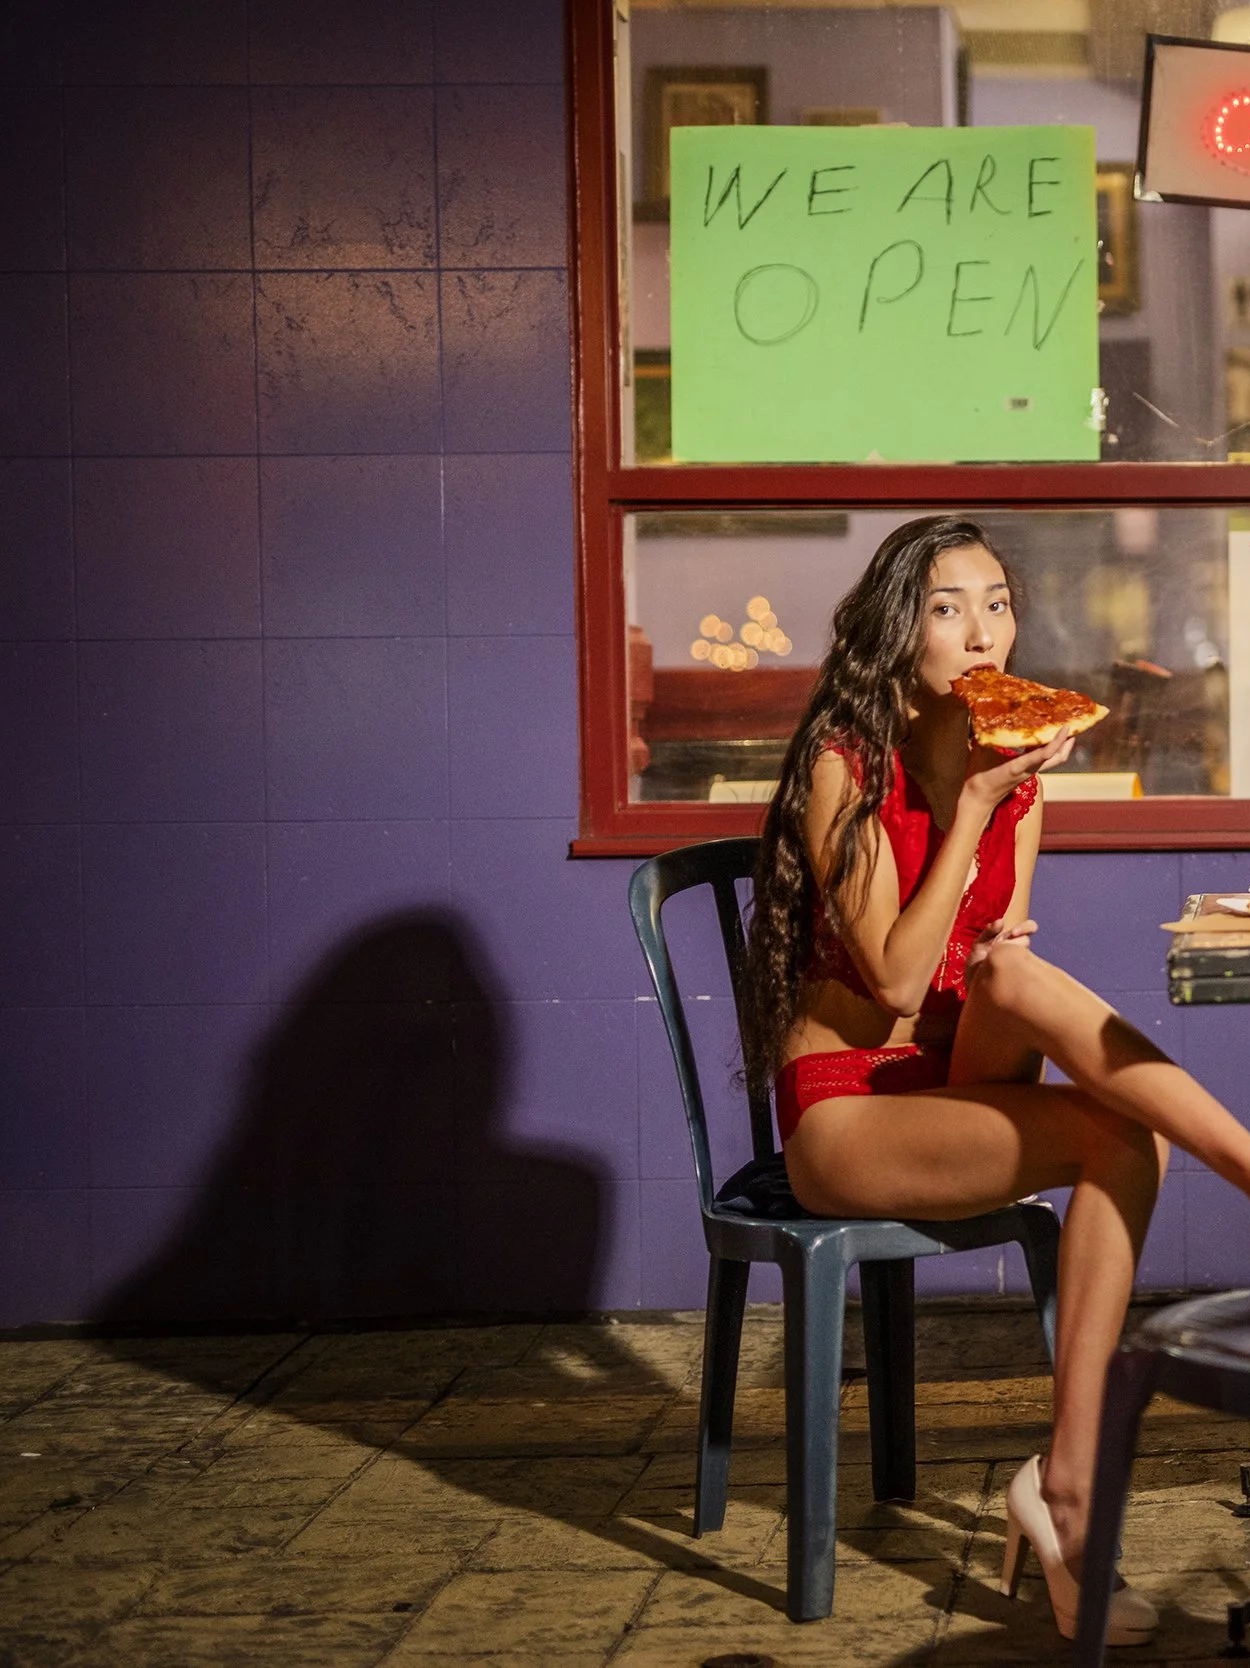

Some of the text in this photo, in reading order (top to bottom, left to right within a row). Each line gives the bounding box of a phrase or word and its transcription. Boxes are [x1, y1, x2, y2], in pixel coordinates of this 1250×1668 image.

[703, 154, 1063, 231] WE ARE
[733, 239, 1085, 352] OPEN
